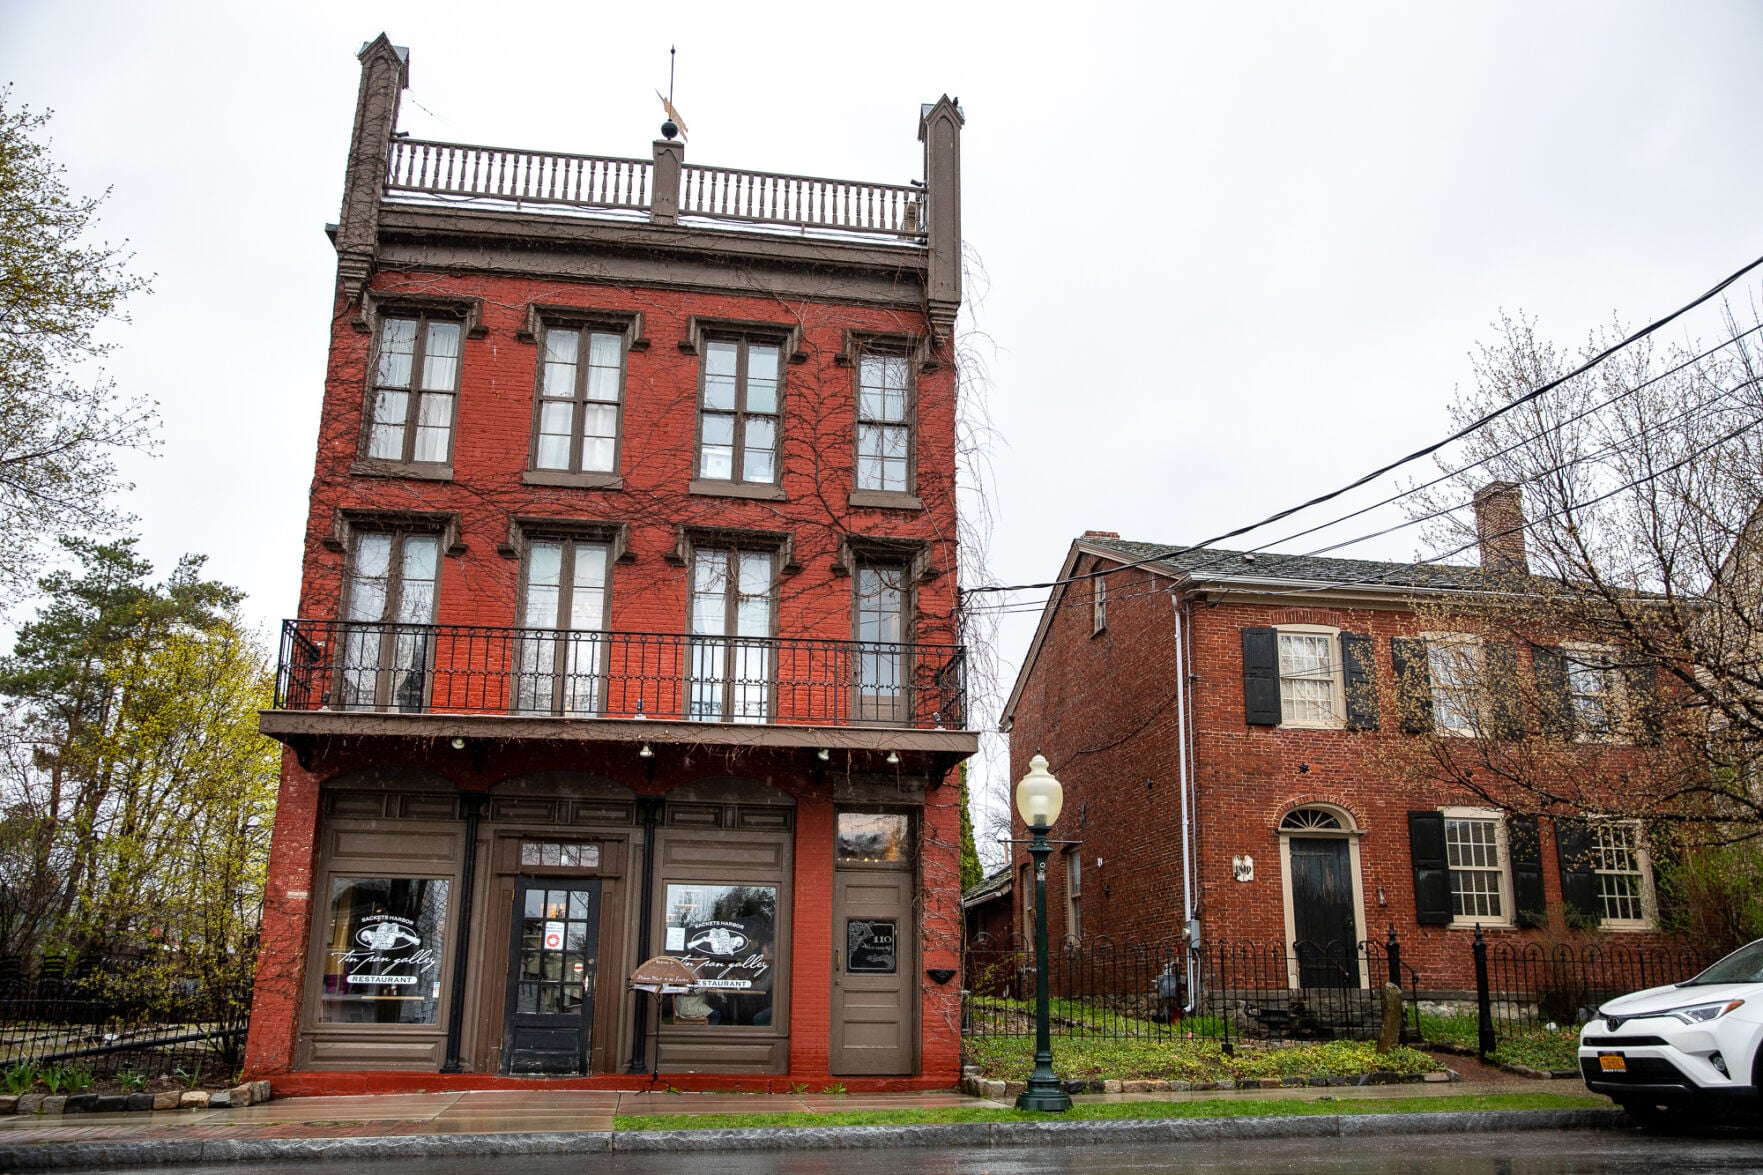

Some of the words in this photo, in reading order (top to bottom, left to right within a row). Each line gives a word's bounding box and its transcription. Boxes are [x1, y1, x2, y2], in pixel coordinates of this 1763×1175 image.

[361, 915, 389, 923] SACKETS
[389, 915, 415, 926] HARBOR
[873, 936, 893, 944] 110
[352, 976, 413, 984] RESTAURANT
[697, 979, 747, 987] ESTAURANT
